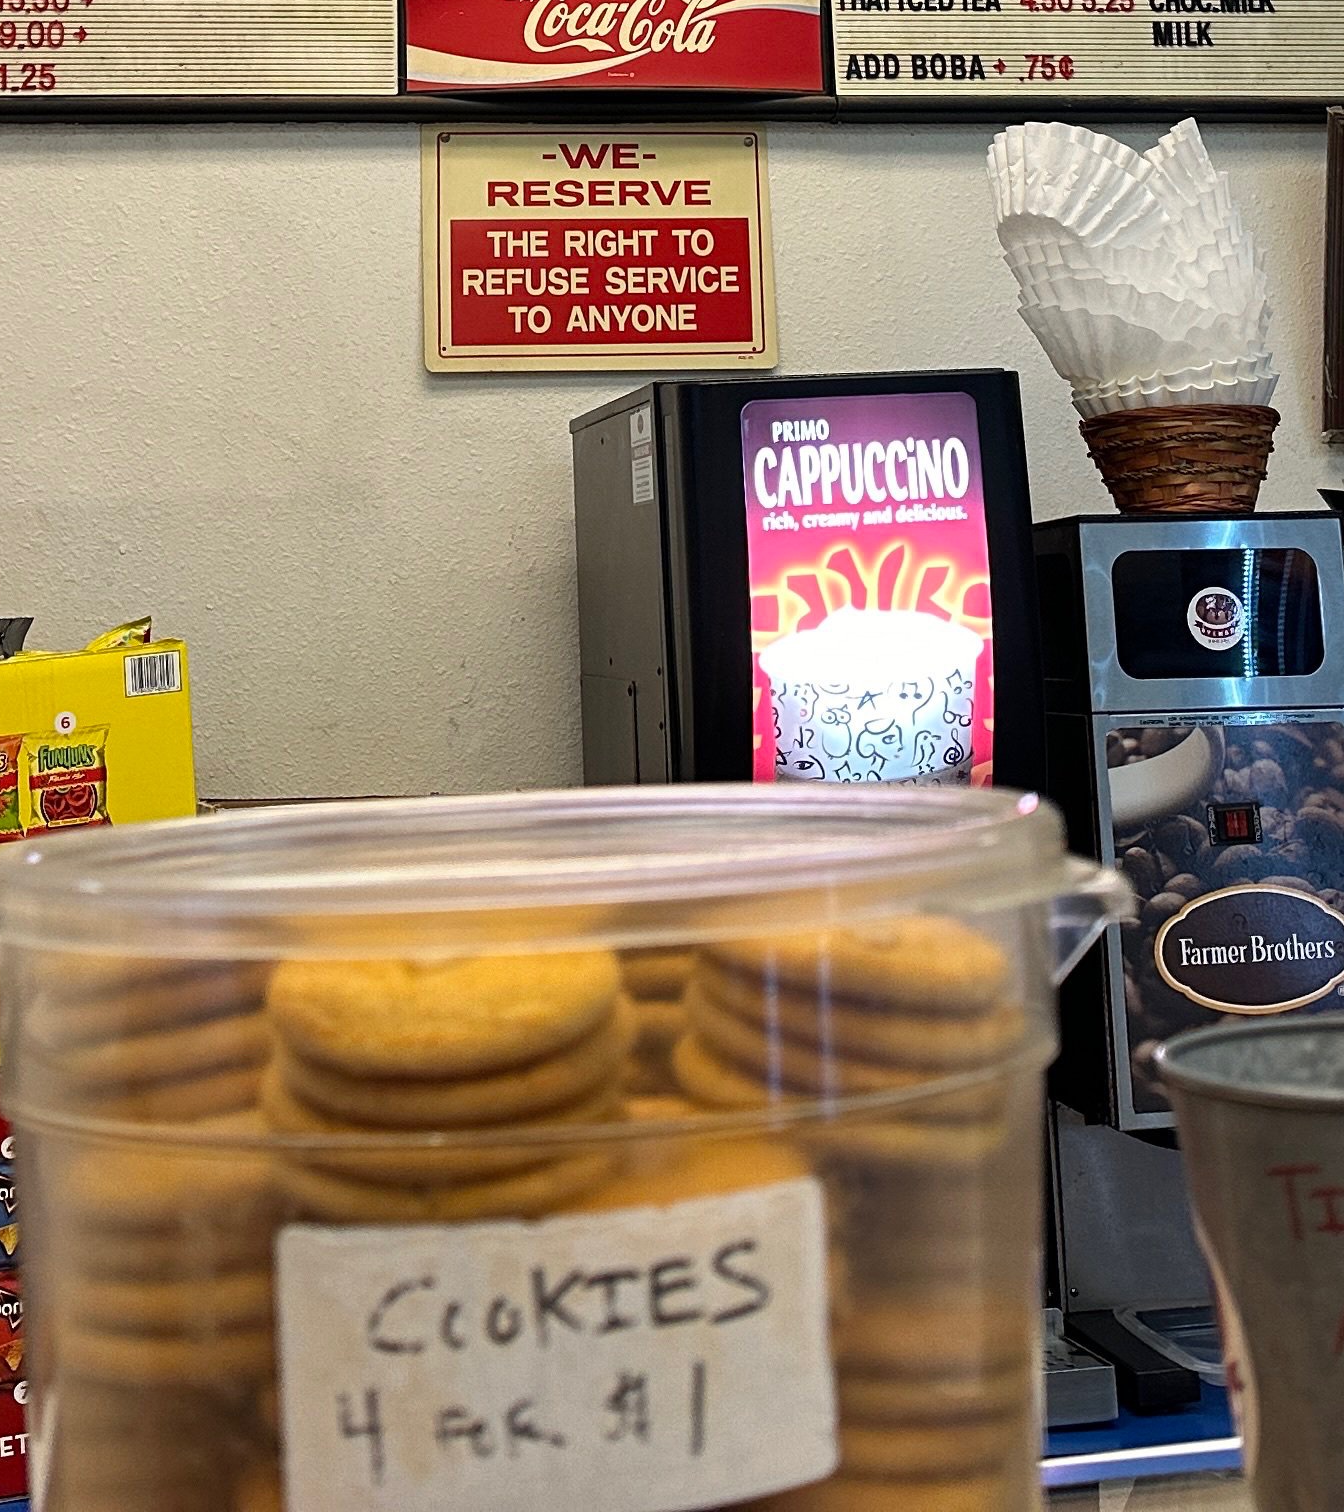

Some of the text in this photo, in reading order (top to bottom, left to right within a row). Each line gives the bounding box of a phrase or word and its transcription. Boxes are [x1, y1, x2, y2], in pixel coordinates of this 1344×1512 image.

[1151, 20, 1214, 47] MILK
[846, 54, 986, 80] ADD BOBA
[487, 179, 712, 207] RESERVE
[486, 229, 715, 258] THE RIGHT TO
[462, 266, 740, 296] REFUSE SERVICE
[507, 304, 697, 334] TO ANYONE
[772, 419, 830, 443] PRIMO
[802, 509, 860, 531] creamy
[862, 508, 892, 525] and
[38, 744, 94, 772] FUNYUNS
[1178, 935, 1336, 967] Farmer Brothers
